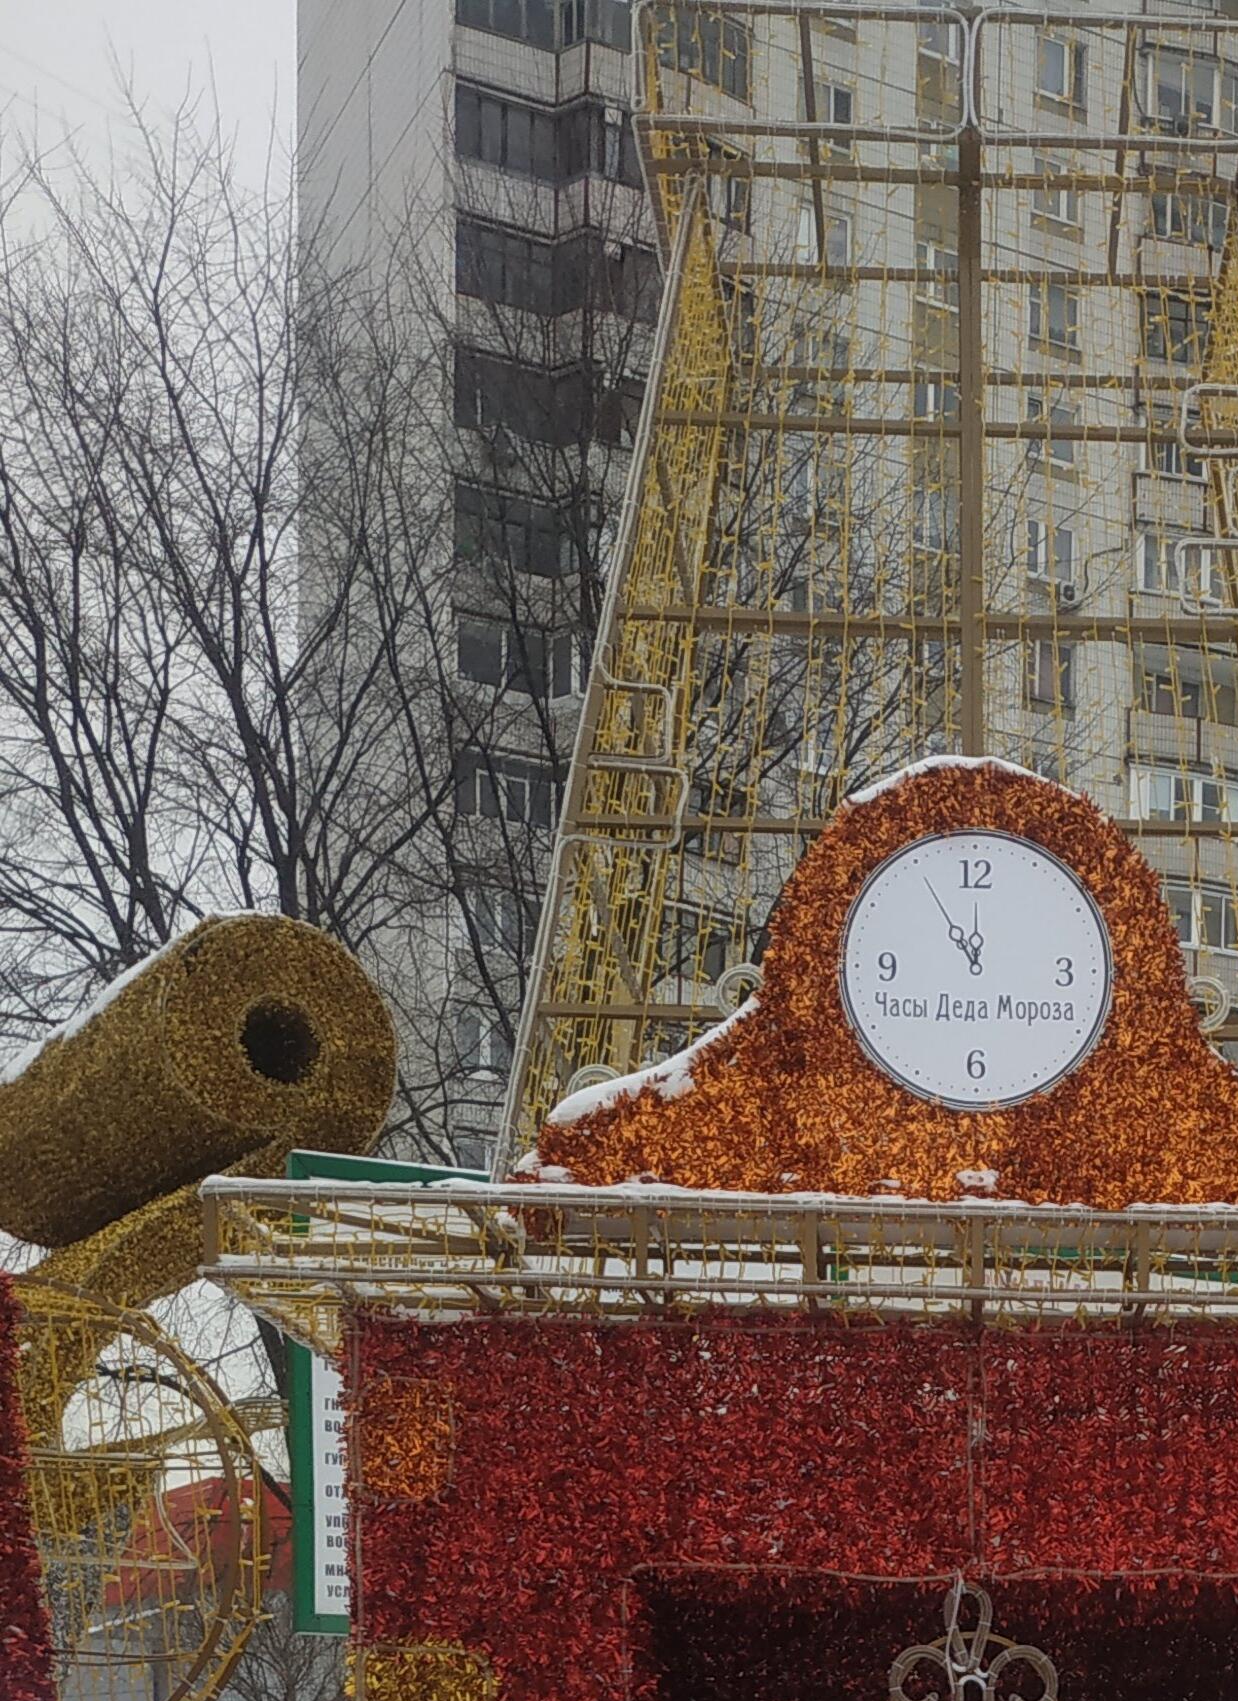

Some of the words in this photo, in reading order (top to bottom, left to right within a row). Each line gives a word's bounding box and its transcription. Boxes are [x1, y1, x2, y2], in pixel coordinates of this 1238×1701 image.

[958, 859, 993, 890] 12
[877, 952, 898, 982] 9
[1054, 957, 1075, 987] 3
[875, 992, 928, 1018] Часы
[936, 993, 989, 1022] Деда
[997, 994, 1074, 1026] Мороза
[966, 1049, 987, 1079] 6
